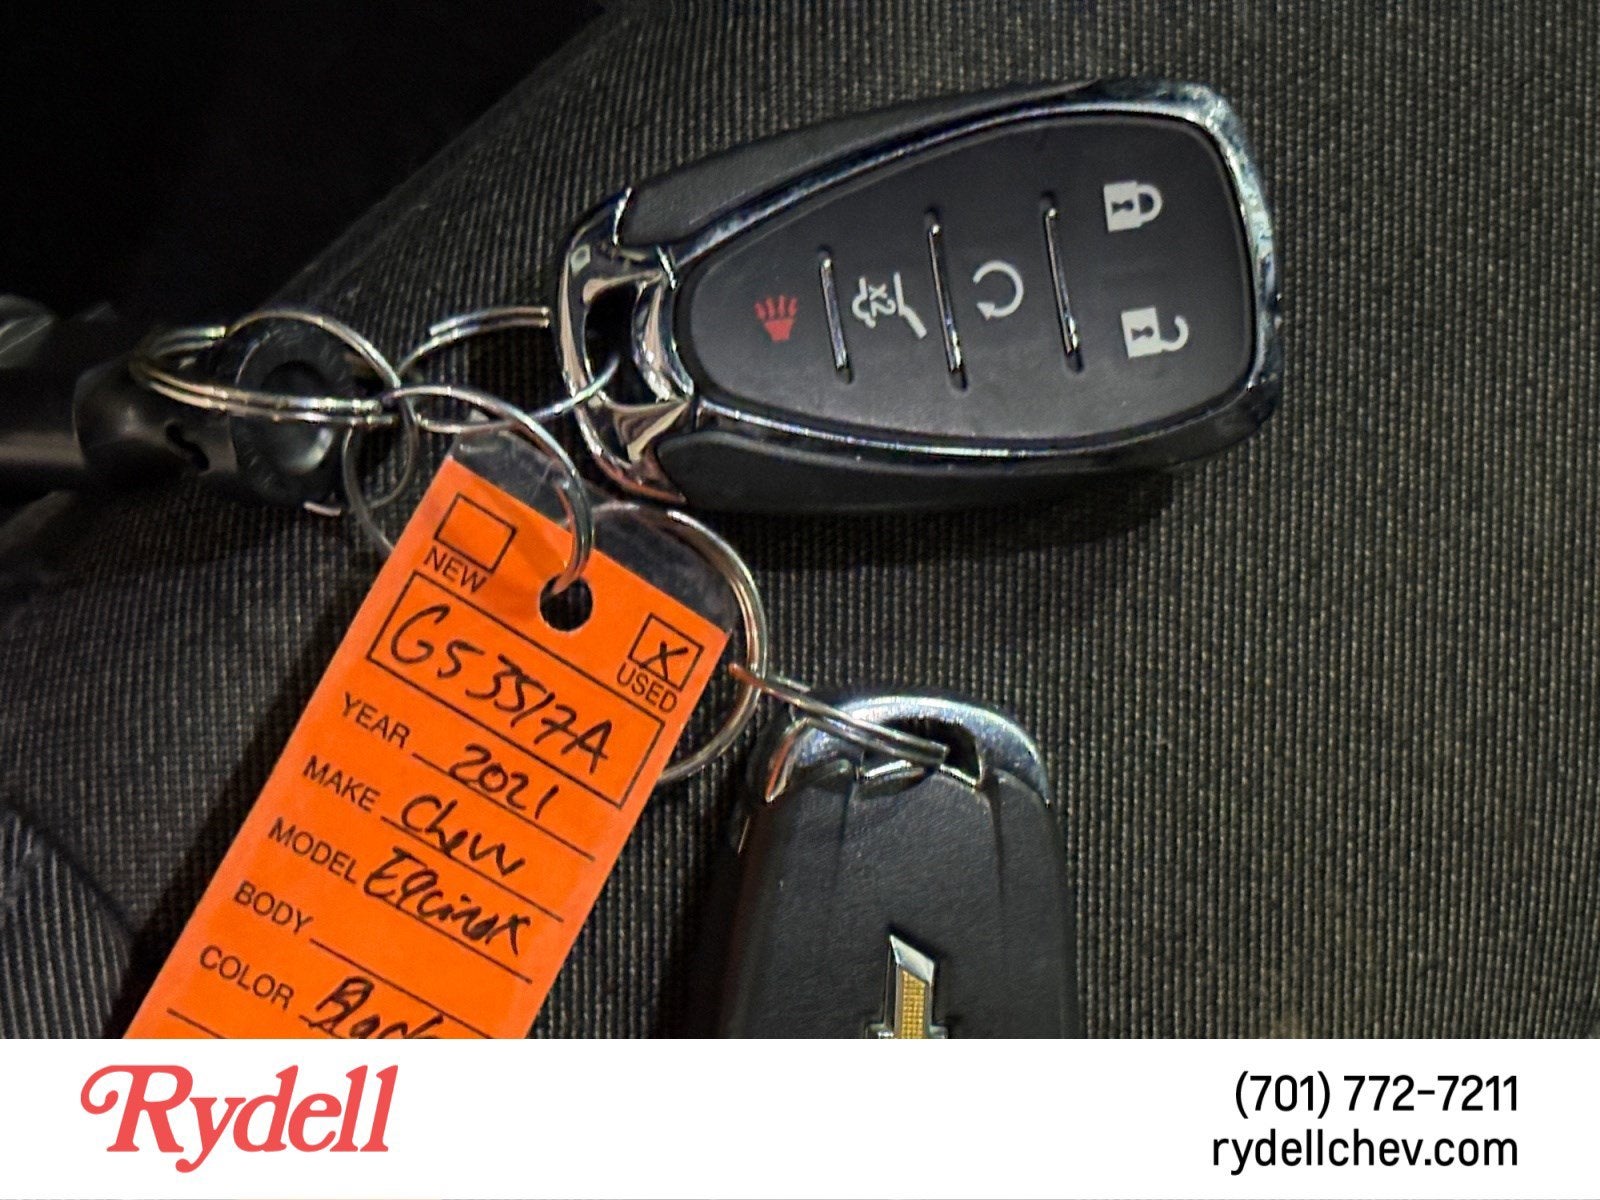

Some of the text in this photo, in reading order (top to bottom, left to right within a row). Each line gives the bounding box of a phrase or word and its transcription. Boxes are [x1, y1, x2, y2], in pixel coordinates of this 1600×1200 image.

[423, 545, 488, 595] NEW
[616, 663, 678, 715] USED
[341, 691, 412, 749] YEAR
[303, 754, 382, 813] MAKE
[448, 742, 560, 820] 2021
[267, 816, 359, 885] MODEL
[233, 880, 315, 935] BODY
[199, 943, 295, 1010] COLOR
